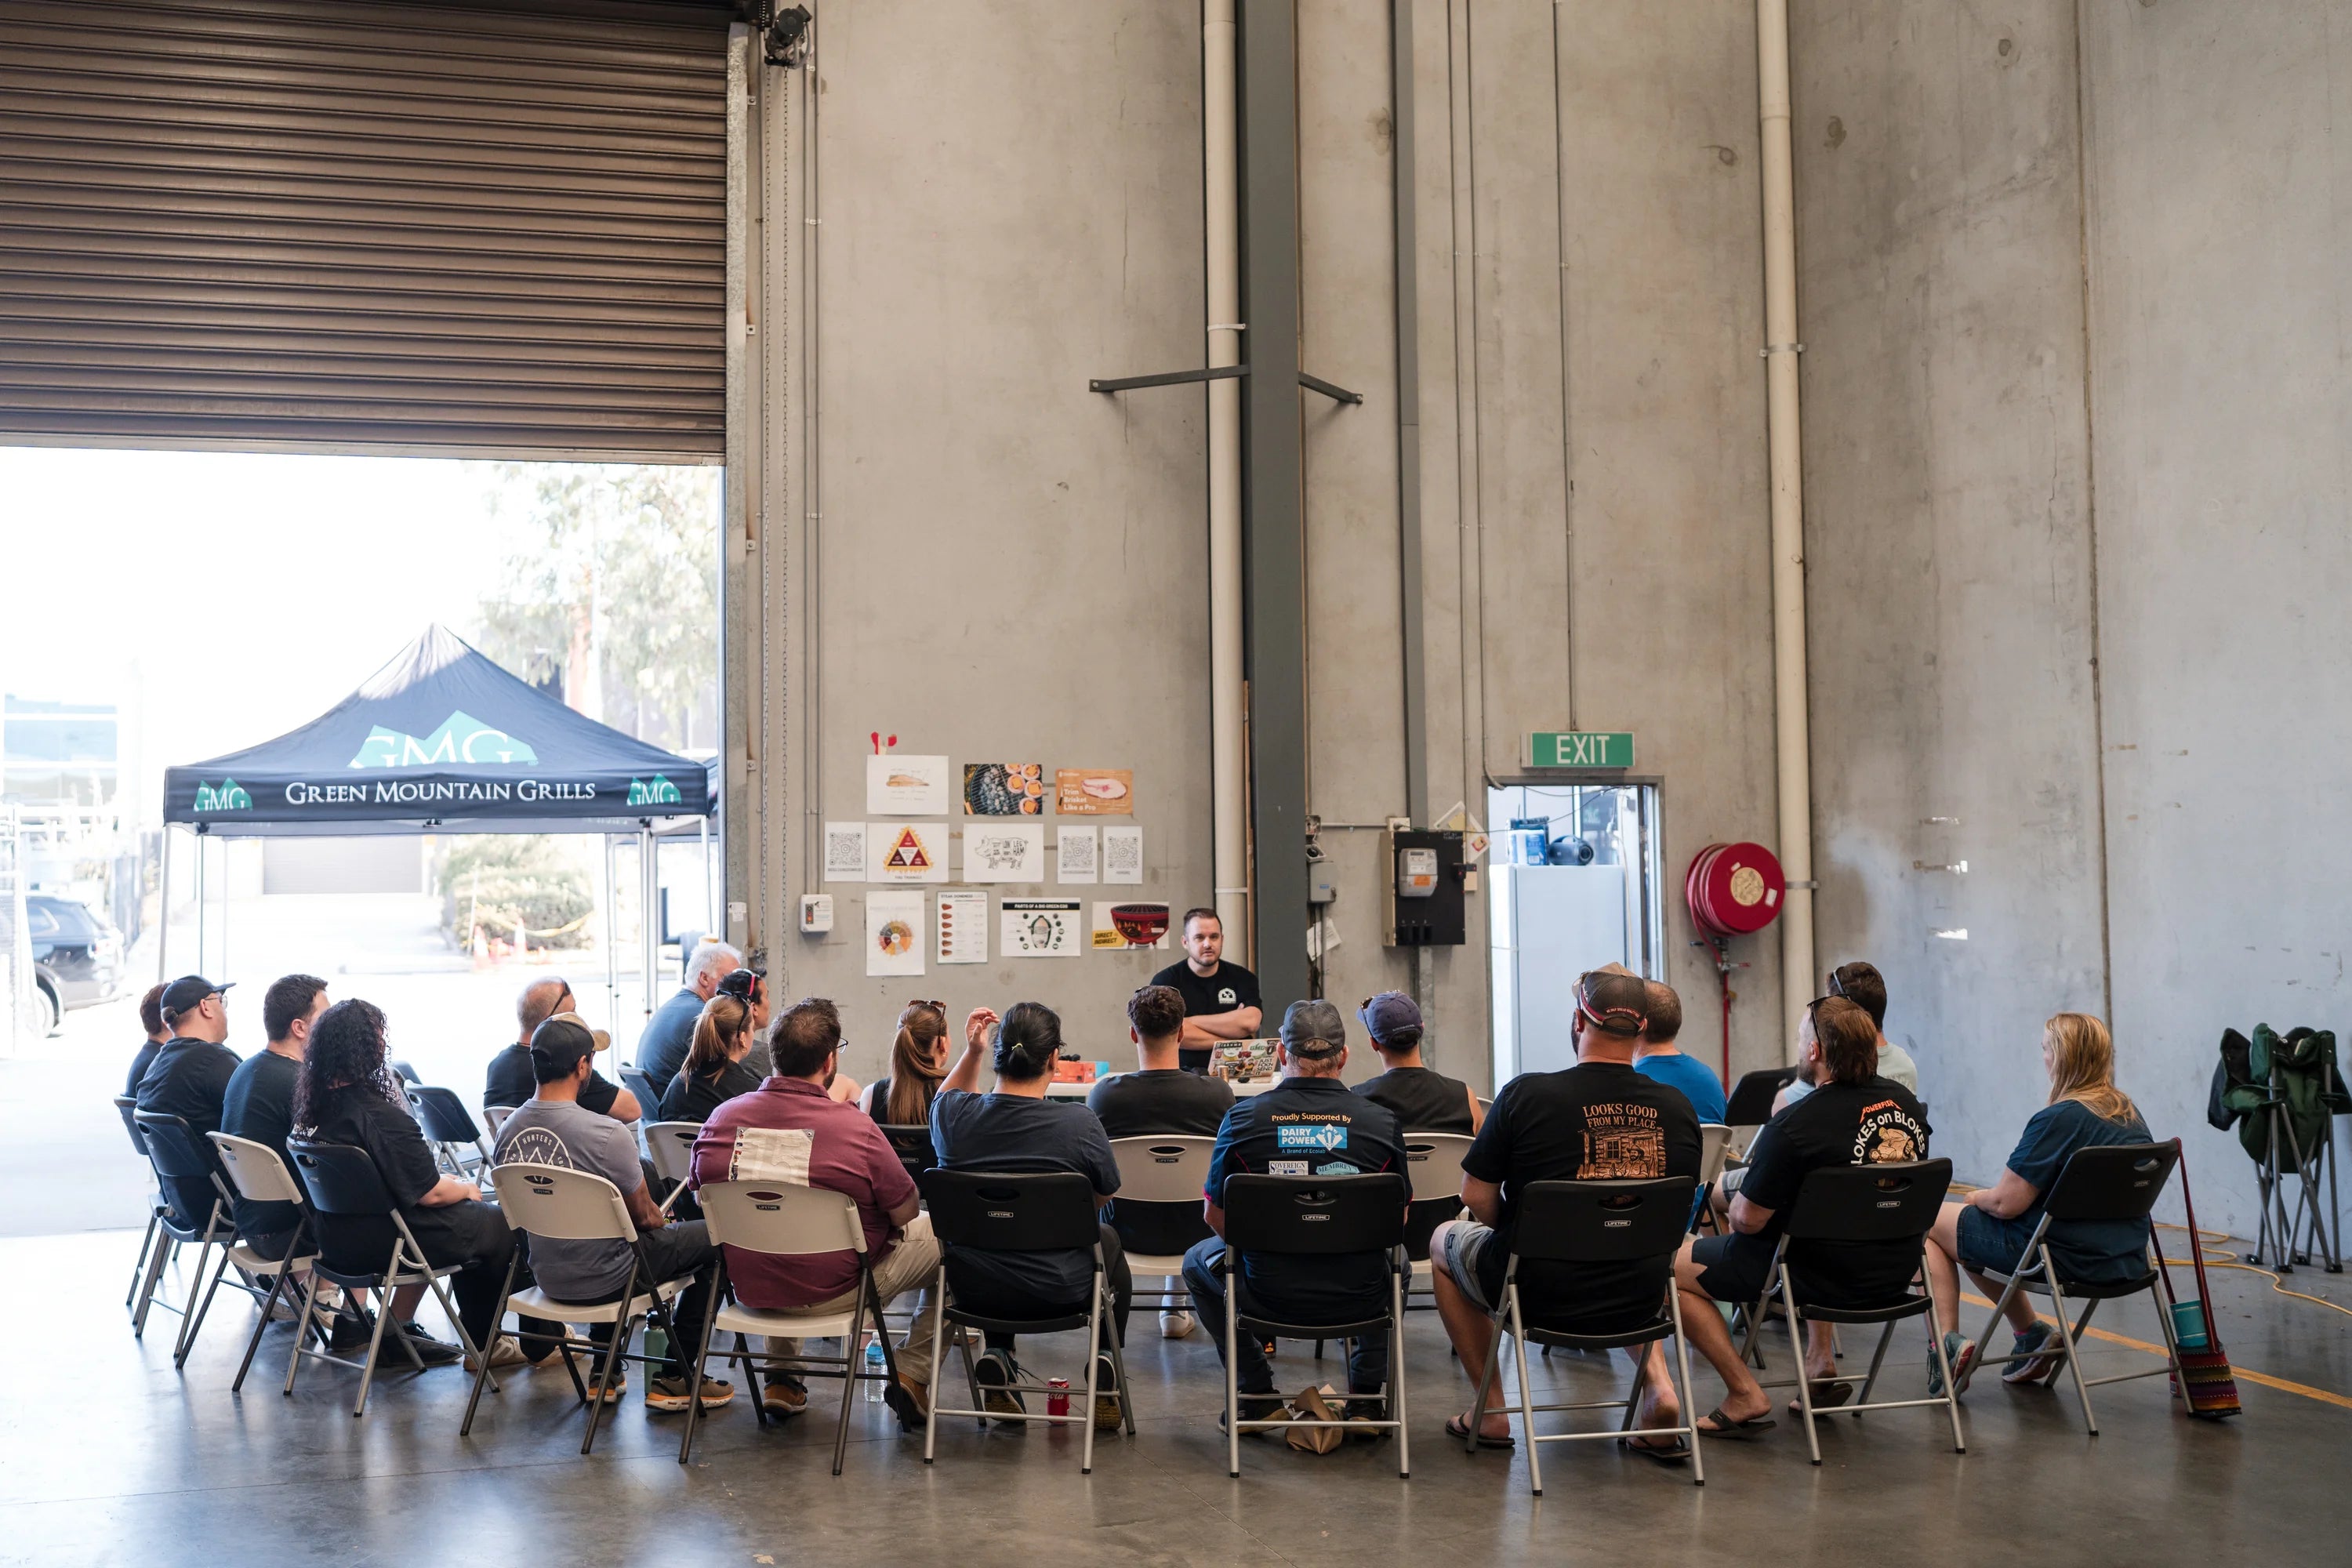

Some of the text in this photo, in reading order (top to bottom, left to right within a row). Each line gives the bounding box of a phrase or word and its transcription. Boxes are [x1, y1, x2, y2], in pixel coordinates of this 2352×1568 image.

[350, 730, 514, 769] GMG
[1556, 735, 1610, 764] EXIT
[194, 787, 245, 812] GMG
[285, 779, 596, 805] GREEN MOUNTAIN GRILLS
[626, 782, 675, 806] GMG
[1272, 1113, 1300, 1122] Proudly
[1302, 1112, 1340, 1121] Supported
[1582, 1104, 1657, 1119] LOOKS GOOD
[1587, 1116, 1657, 1129] FROM MY PLACE
[522, 1134, 553, 1146] HUNTERS
[1851, 1111, 1926, 1165] LOKES on BLOKES
[1270, 1162, 1305, 1174] SOVEREIGN
